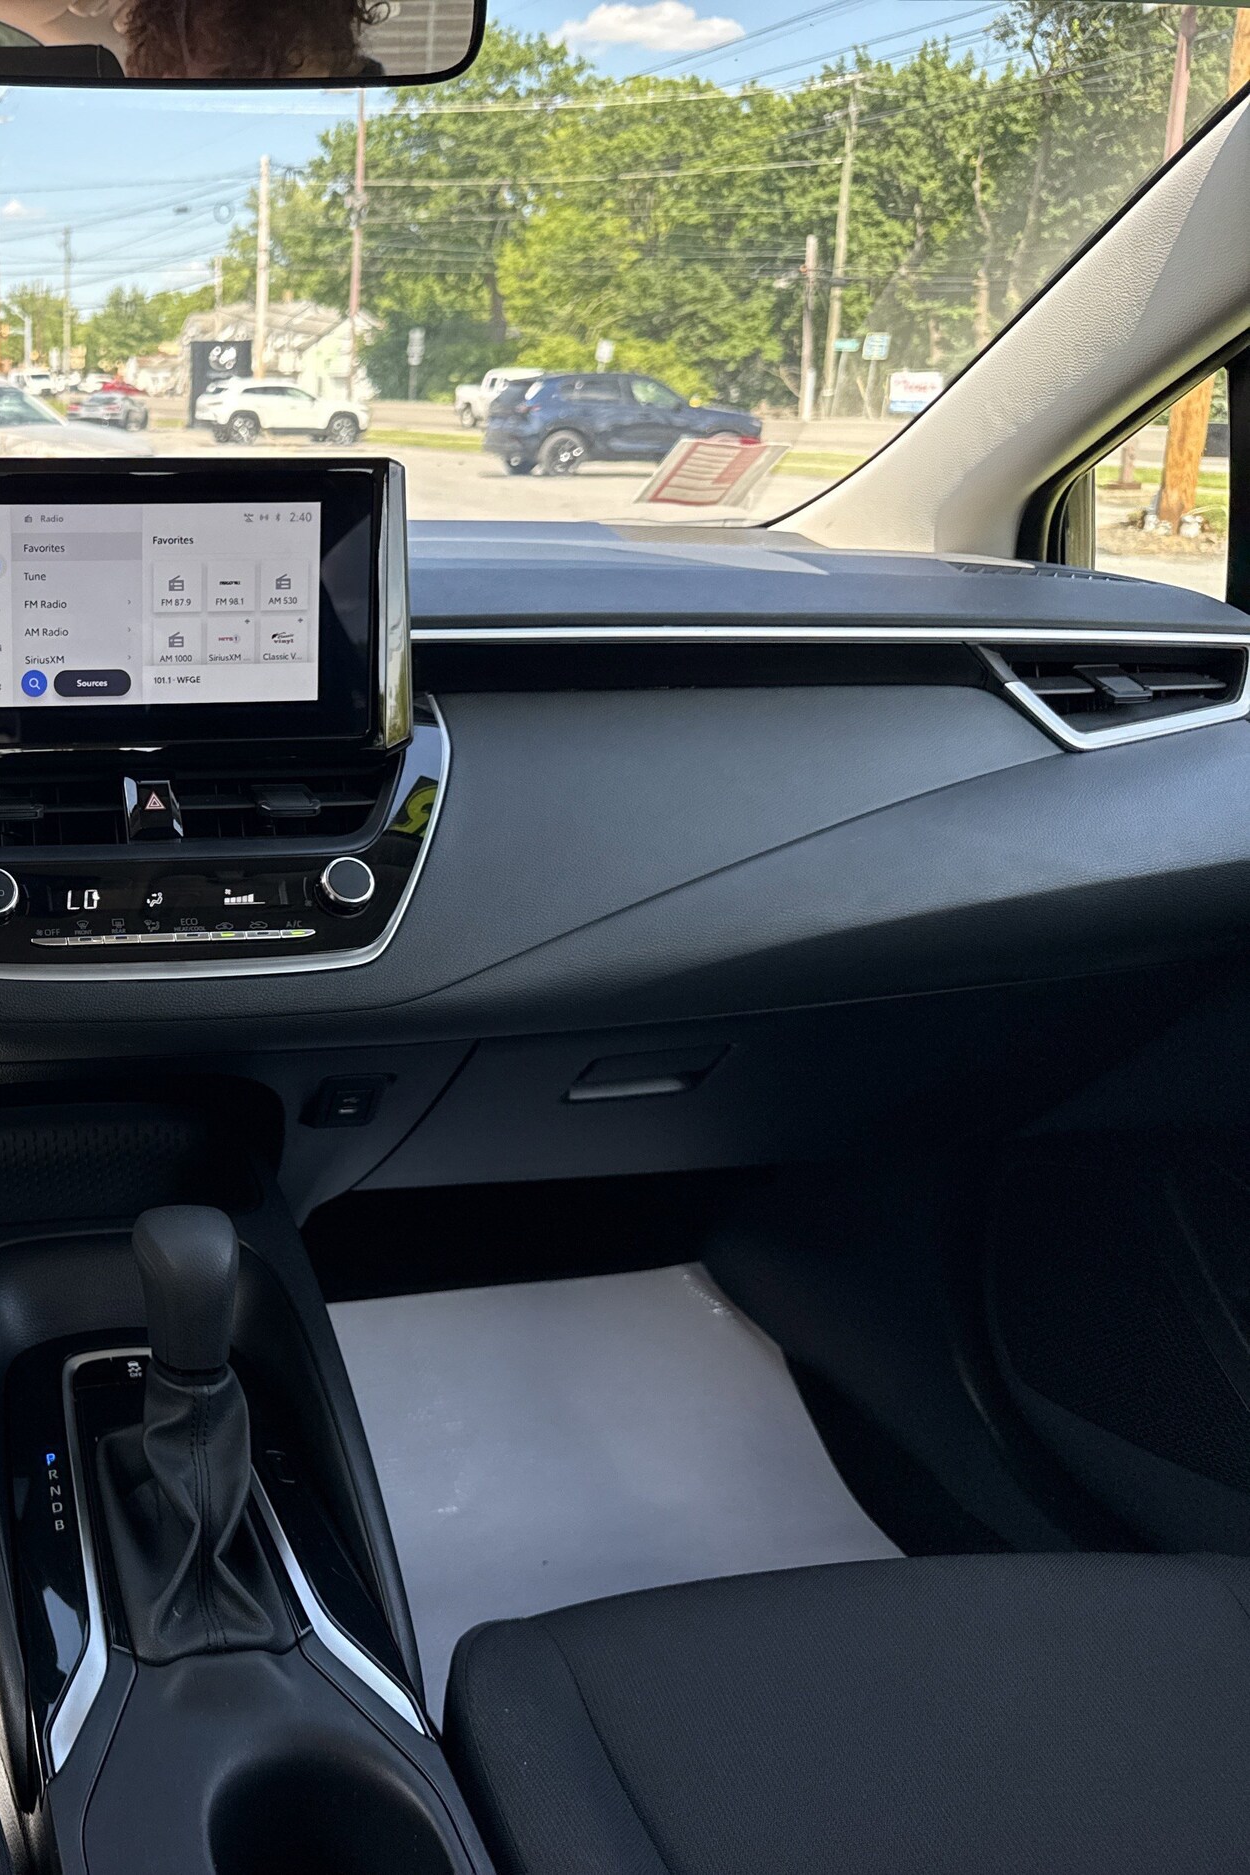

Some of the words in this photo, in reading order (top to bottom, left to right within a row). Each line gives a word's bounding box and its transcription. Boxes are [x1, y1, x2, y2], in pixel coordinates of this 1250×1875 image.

[40, 514, 64, 522] Radio
[290, 512, 312, 522] 2:40
[152, 535, 194, 545] Favorites
[23, 544, 65, 552] Favorites
[24, 572, 46, 581] Tune
[24, 600, 38, 608] FM
[40, 600, 67, 608] Radio
[268, 597, 281, 605] AM
[24, 628, 40, 636] AM
[42, 627, 69, 636] Radio
[25, 656, 64, 664] SiriusXM
[160, 655, 173, 663] AM
[209, 654, 242, 662] SiriusXM
[263, 653, 289, 661] Classic
[76, 679, 108, 688] Sources
[177, 676, 201, 684] WFGE
[180, 917, 198, 926] ECO
[286, 920, 303, 928] A/C
[44, 928, 61, 936] OFF
[46, 1452, 56, 1466] P
[48, 1469, 59, 1480] R
[50, 1485, 61, 1497] N
[52, 1502, 63, 1513] D
[55, 1519, 65, 1531] B
